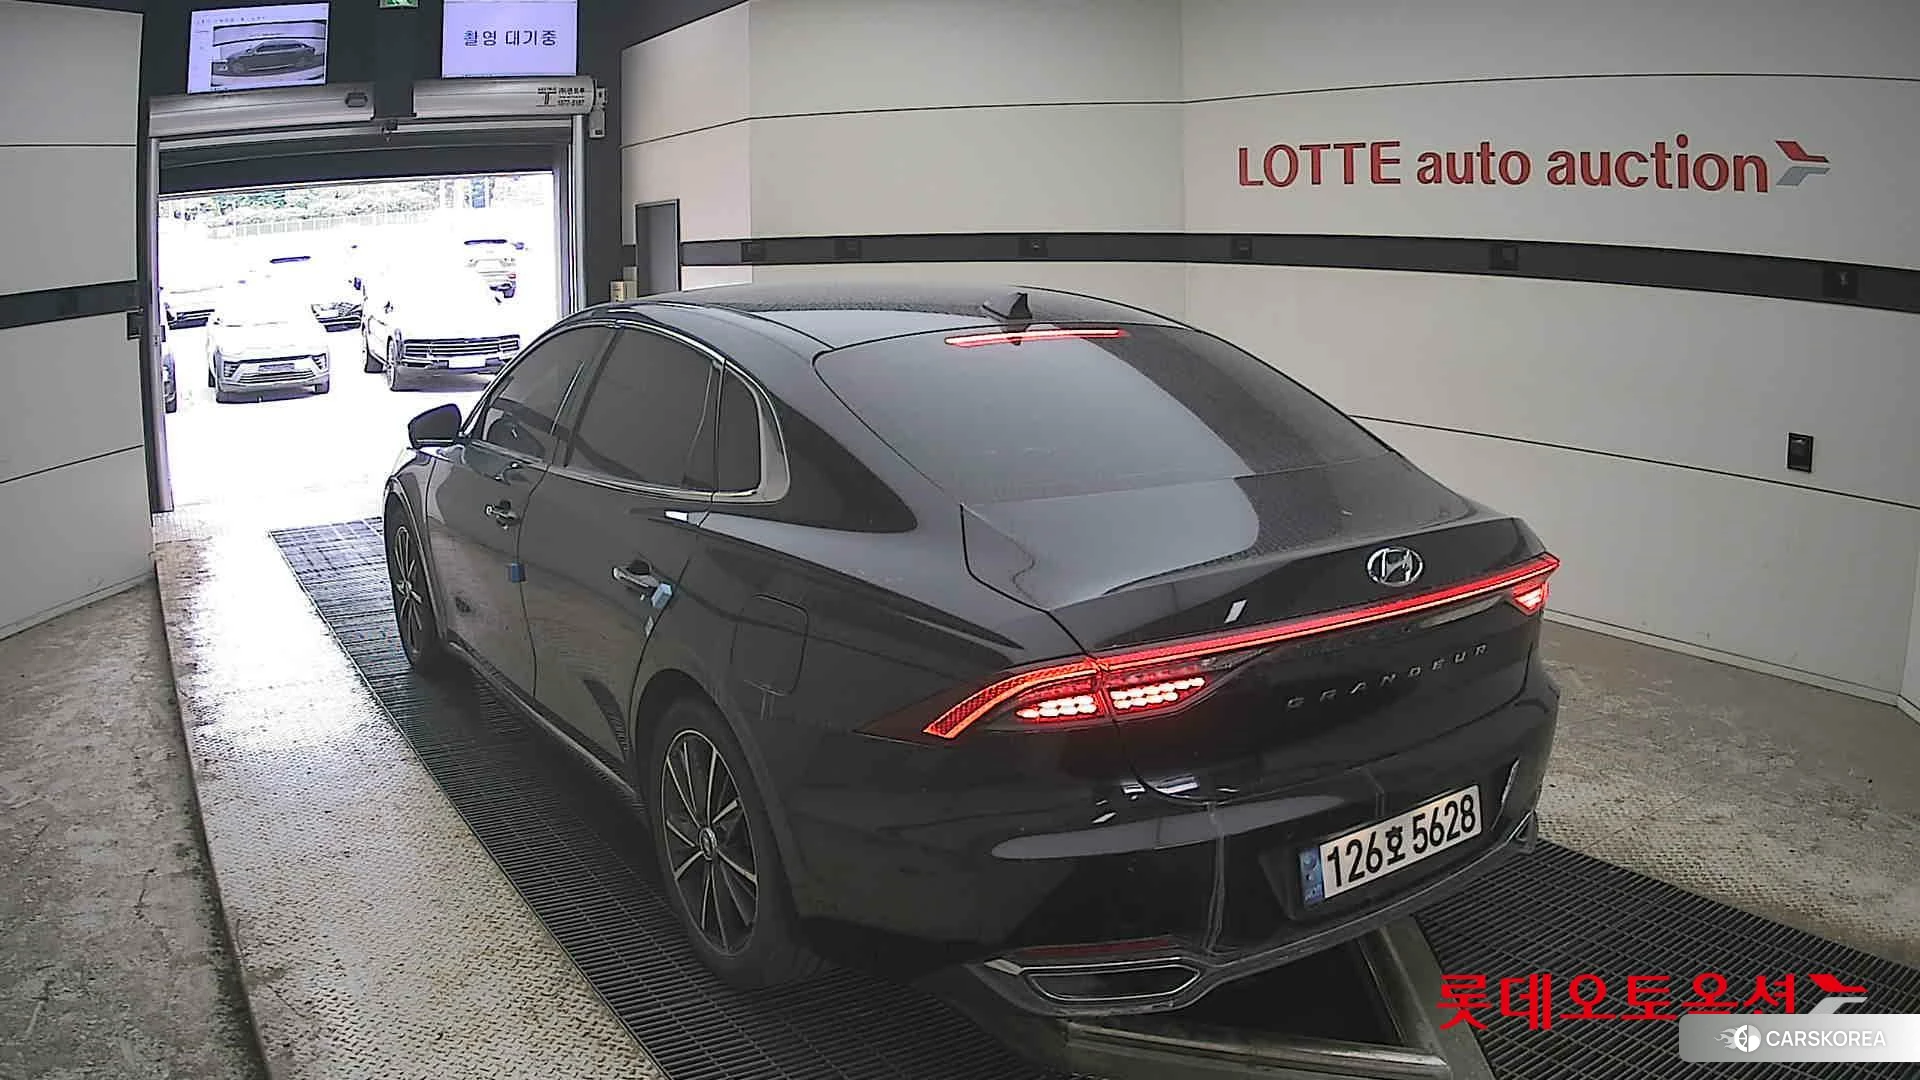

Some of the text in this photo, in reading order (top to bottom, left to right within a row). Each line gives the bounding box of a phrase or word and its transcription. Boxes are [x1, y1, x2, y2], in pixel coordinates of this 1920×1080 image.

[505, 29, 558, 47] 대기중
[1238, 133, 1769, 194] LOTTE auto auction
[1287, 643, 1487, 709] GRANDEUR
